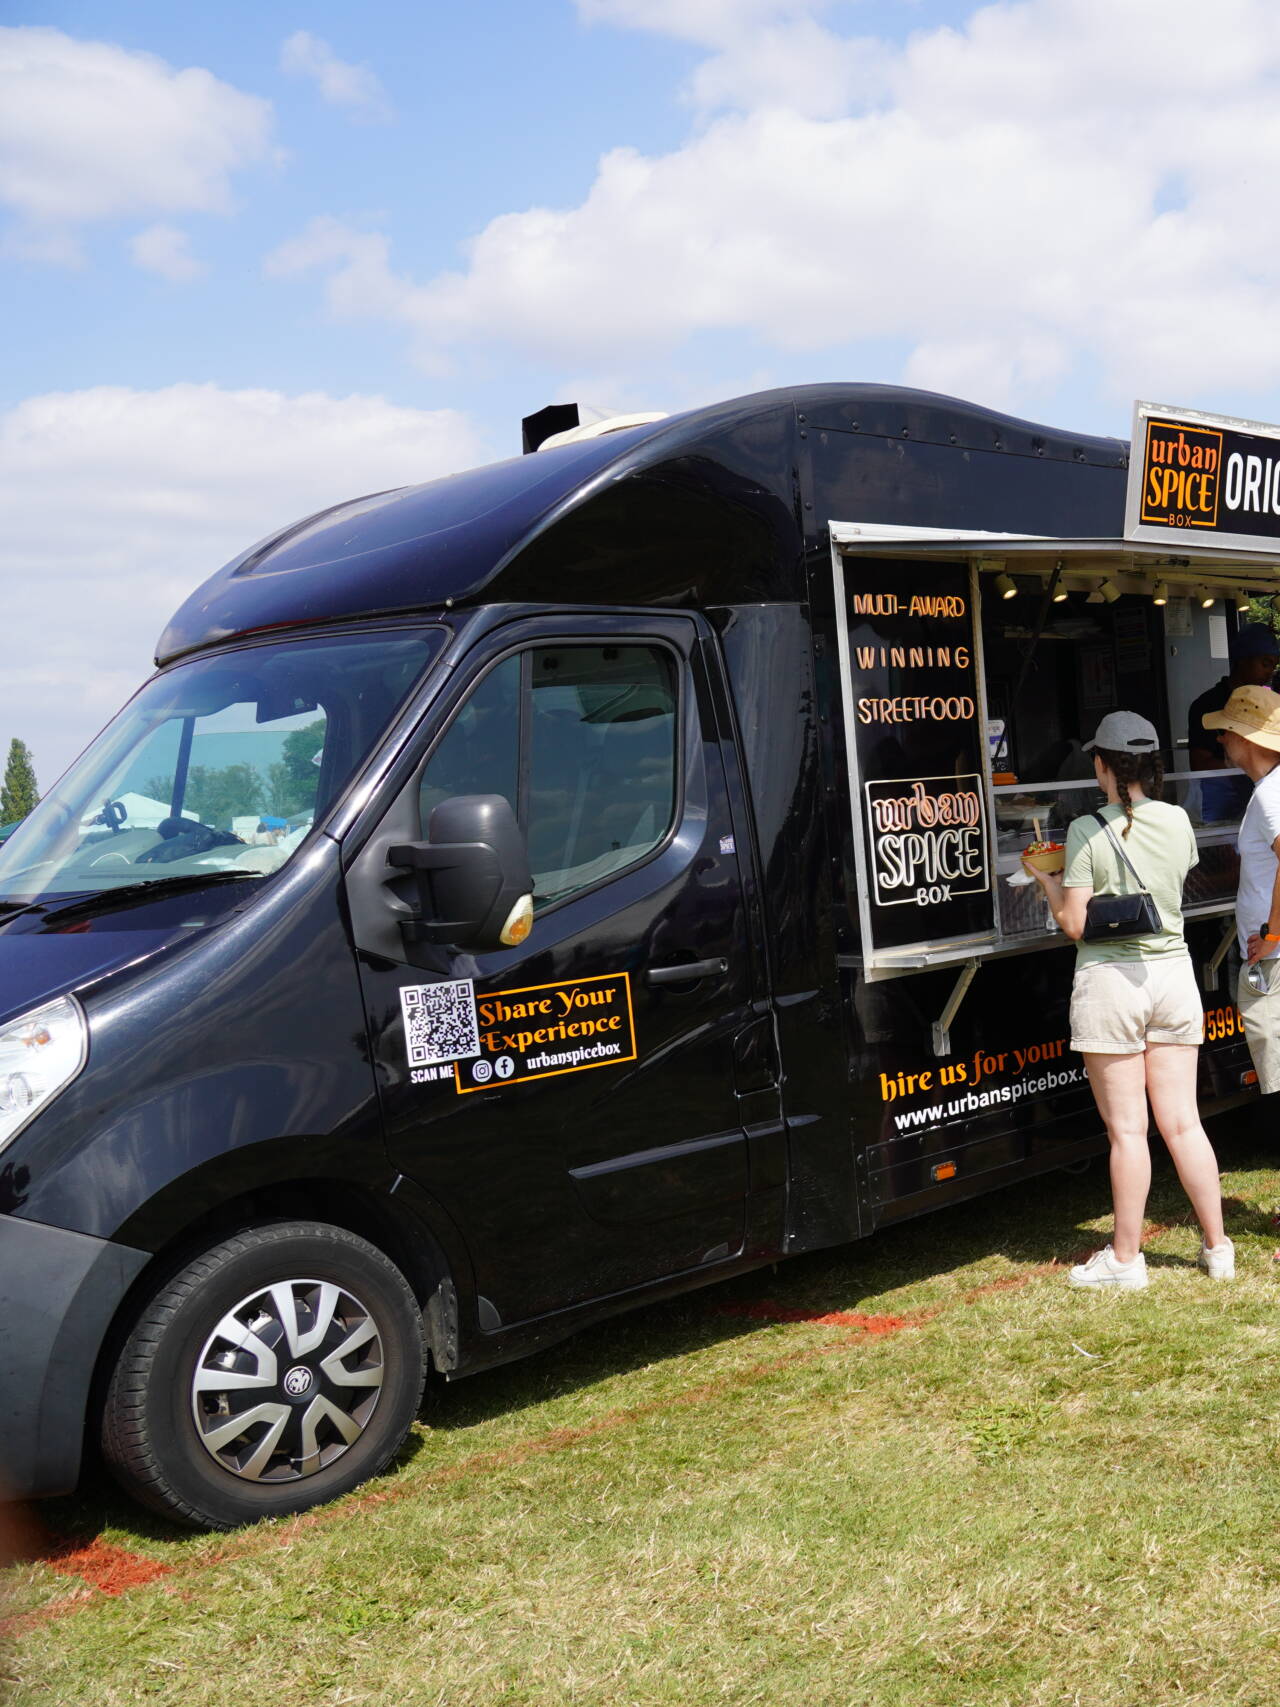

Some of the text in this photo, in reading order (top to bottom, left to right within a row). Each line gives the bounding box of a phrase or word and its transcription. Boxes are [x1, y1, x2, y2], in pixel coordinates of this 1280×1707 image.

[1151, 432, 1217, 474] urban
[1146, 467, 1214, 513] SPICE
[1168, 515, 1191, 528] BOX
[853, 592, 965, 618] MULTI-AWARD
[856, 646, 969, 669] WINNING
[858, 696, 974, 725] STREETFOOD
[872, 782, 981, 833] urban
[877, 826, 983, 889] SPICE
[917, 884, 953, 906] BOX
[479, 988, 617, 1027] Share Your
[480, 1014, 622, 1052] Experience
[526, 1042, 621, 1069] urbanspicebox
[879, 1038, 1066, 1103] hire us for your
[410, 1066, 455, 1084] SCAN ME
